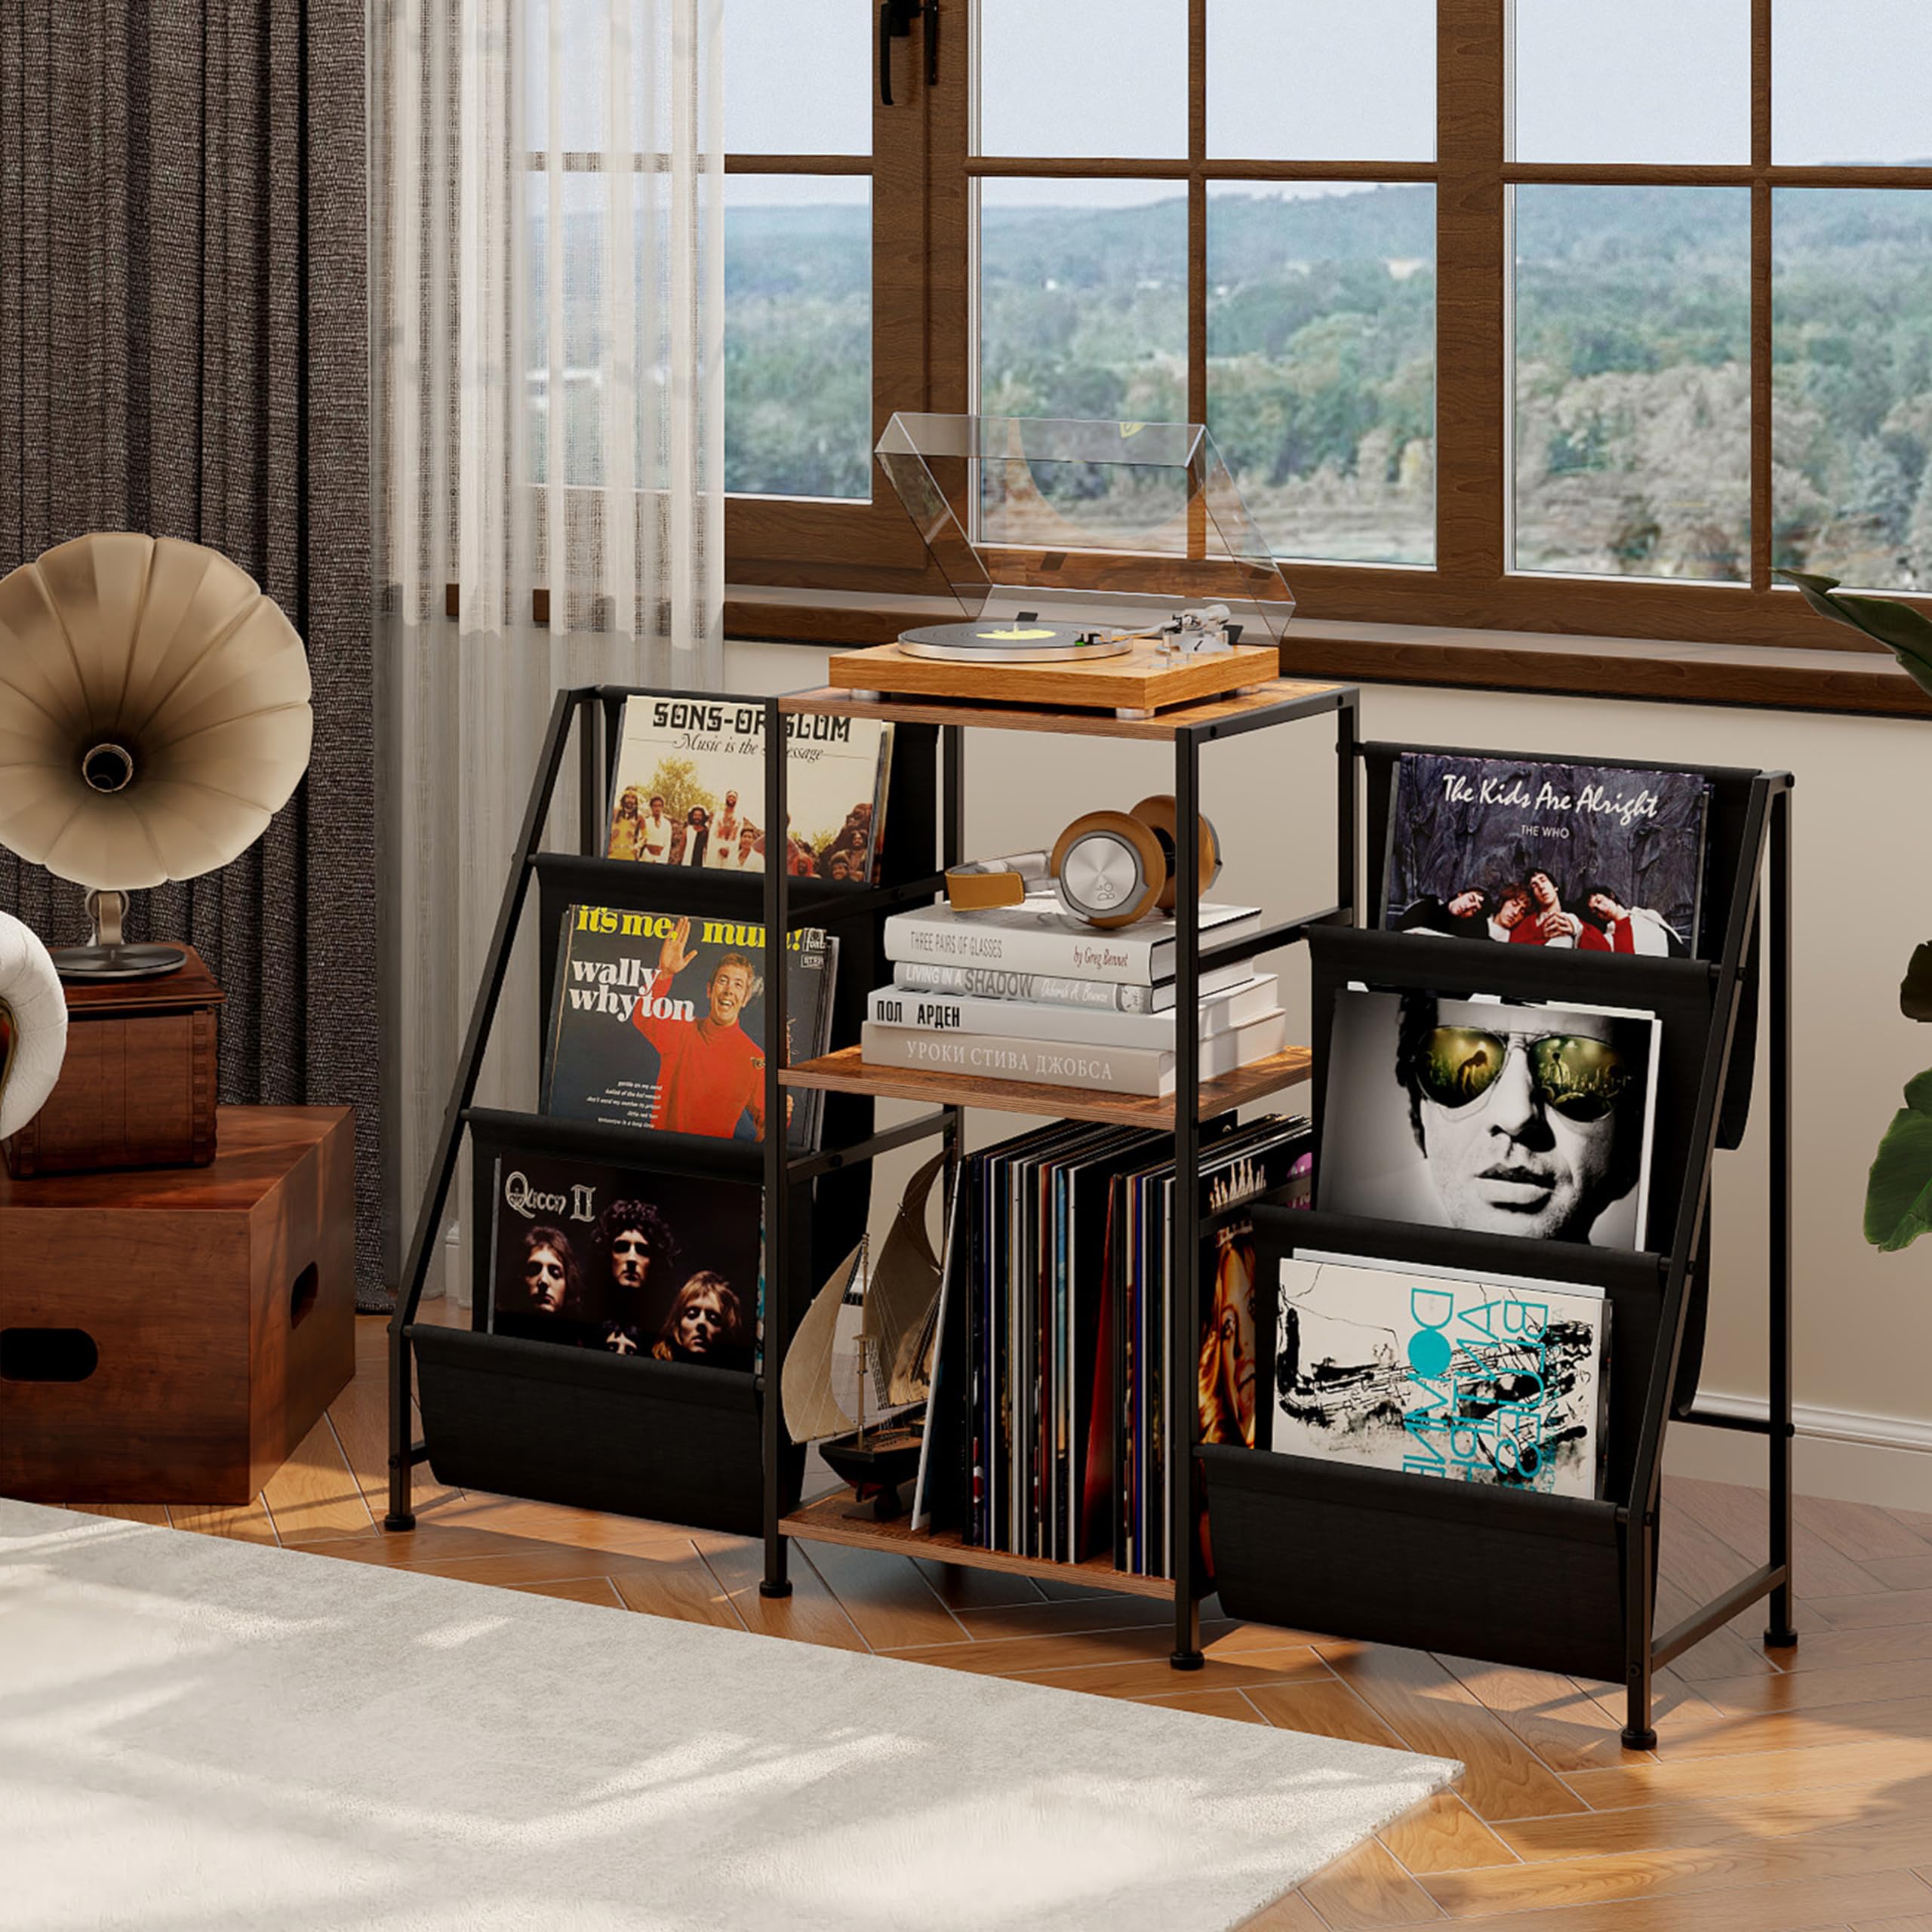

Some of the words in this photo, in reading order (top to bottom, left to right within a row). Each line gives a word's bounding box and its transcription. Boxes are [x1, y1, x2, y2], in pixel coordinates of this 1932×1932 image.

[673, 734, 721, 751] Music
[724, 737, 734, 753] is
[739, 737, 756, 755] the
[1442, 774, 1474, 803] The
[1479, 777, 1531, 808] Kids
[1534, 782, 1572, 811] Are
[1575, 784, 1659, 826] Alright
[1521, 824, 1539, 836] THE
[1542, 826, 1570, 839] WHO
[911, 931, 933, 952] THREE
[935, 934, 956, 954] PAIRS
[958, 936, 968, 955] OF
[970, 937, 1002, 958] GLASSES
[1073, 946, 1082, 968] by
[1084, 946, 1102, 970] Greg
[1103, 948, 1128, 967] Bennet
[571, 958, 662, 997] wally
[906, 964, 940, 983] LIVING
[942, 967, 953, 985] IN
[954, 970, 962, 986] A
[964, 969, 1034, 998] SHADOW
[568, 984, 695, 1023] whyton
[876, 1000, 903, 1023] ПОЛ
[917, 1004, 960, 1029] АРДЕН
[906, 1040, 965, 1063] УРОКИ
[971, 1047, 1029, 1071] СТИВА
[1035, 1054, 1113, 1080] ДЖОБСА
[505, 1171, 567, 1219] Queen
